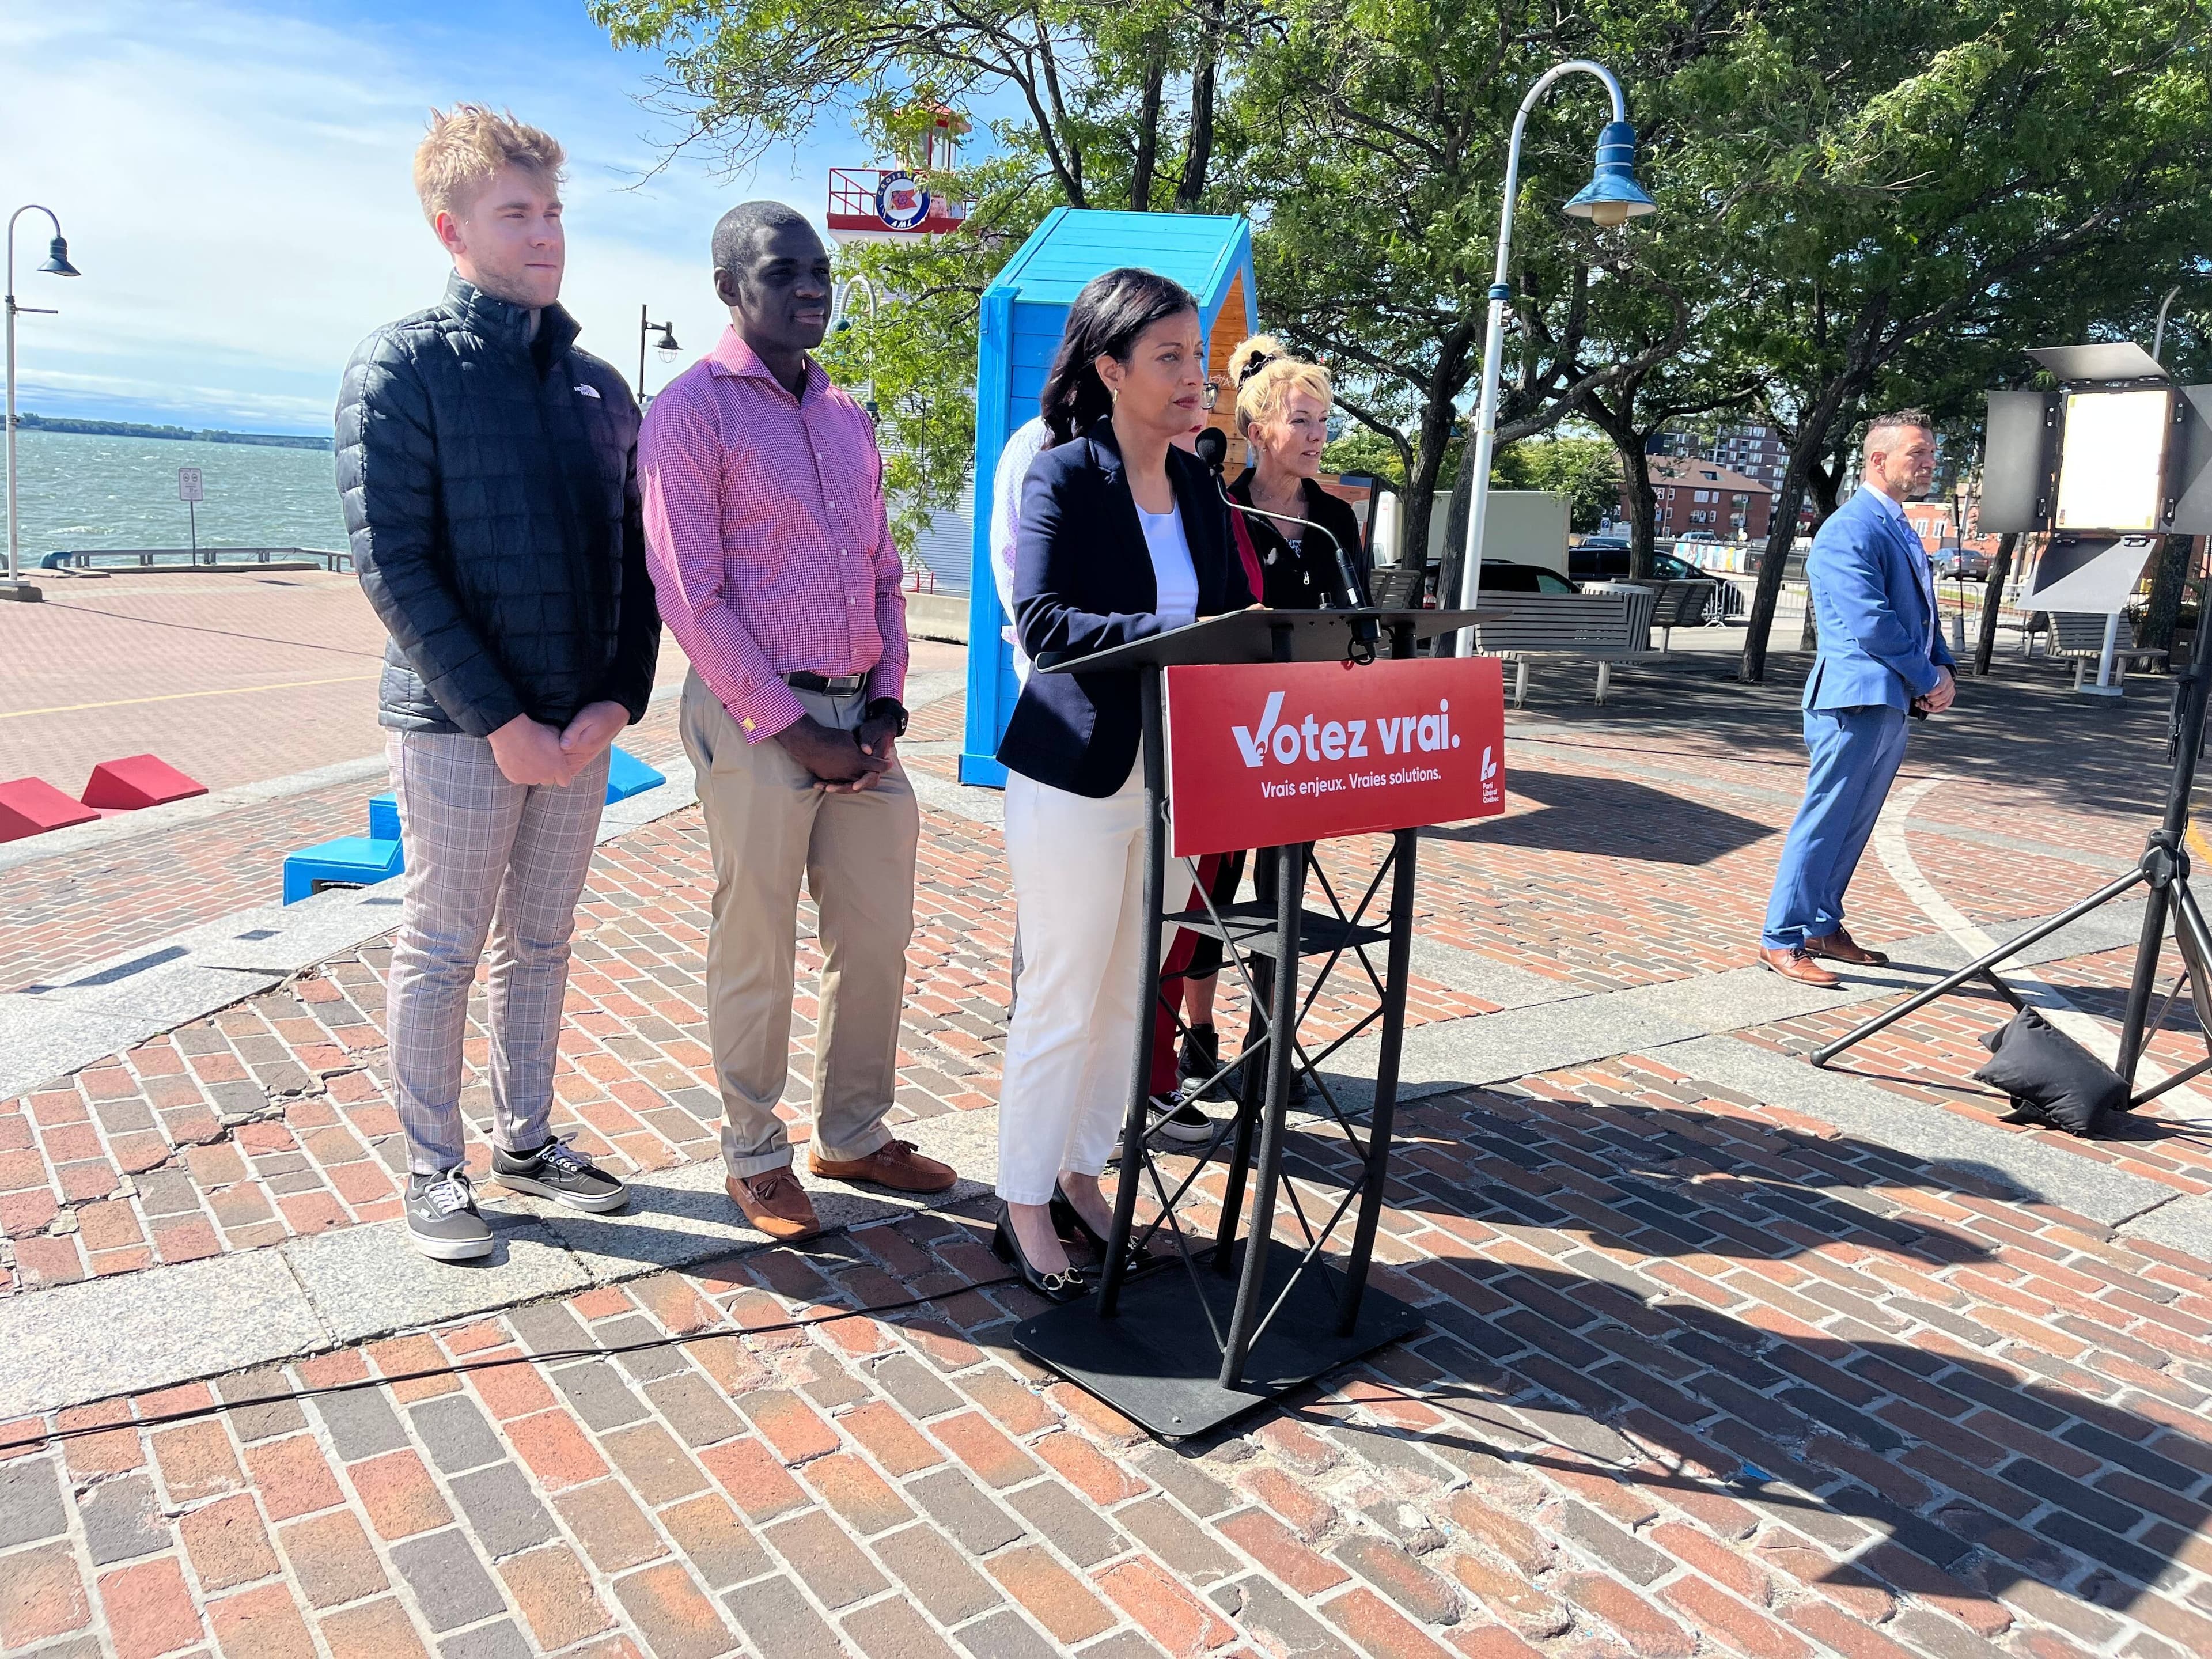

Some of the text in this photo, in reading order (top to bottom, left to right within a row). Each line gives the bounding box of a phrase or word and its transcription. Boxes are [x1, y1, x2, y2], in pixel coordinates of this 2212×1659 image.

[891, 219, 912, 228] AML
[1231, 691, 1460, 767] Votez vrai.
[1261, 766, 1441, 798] Vrais enjeux. Vraies solutions.
